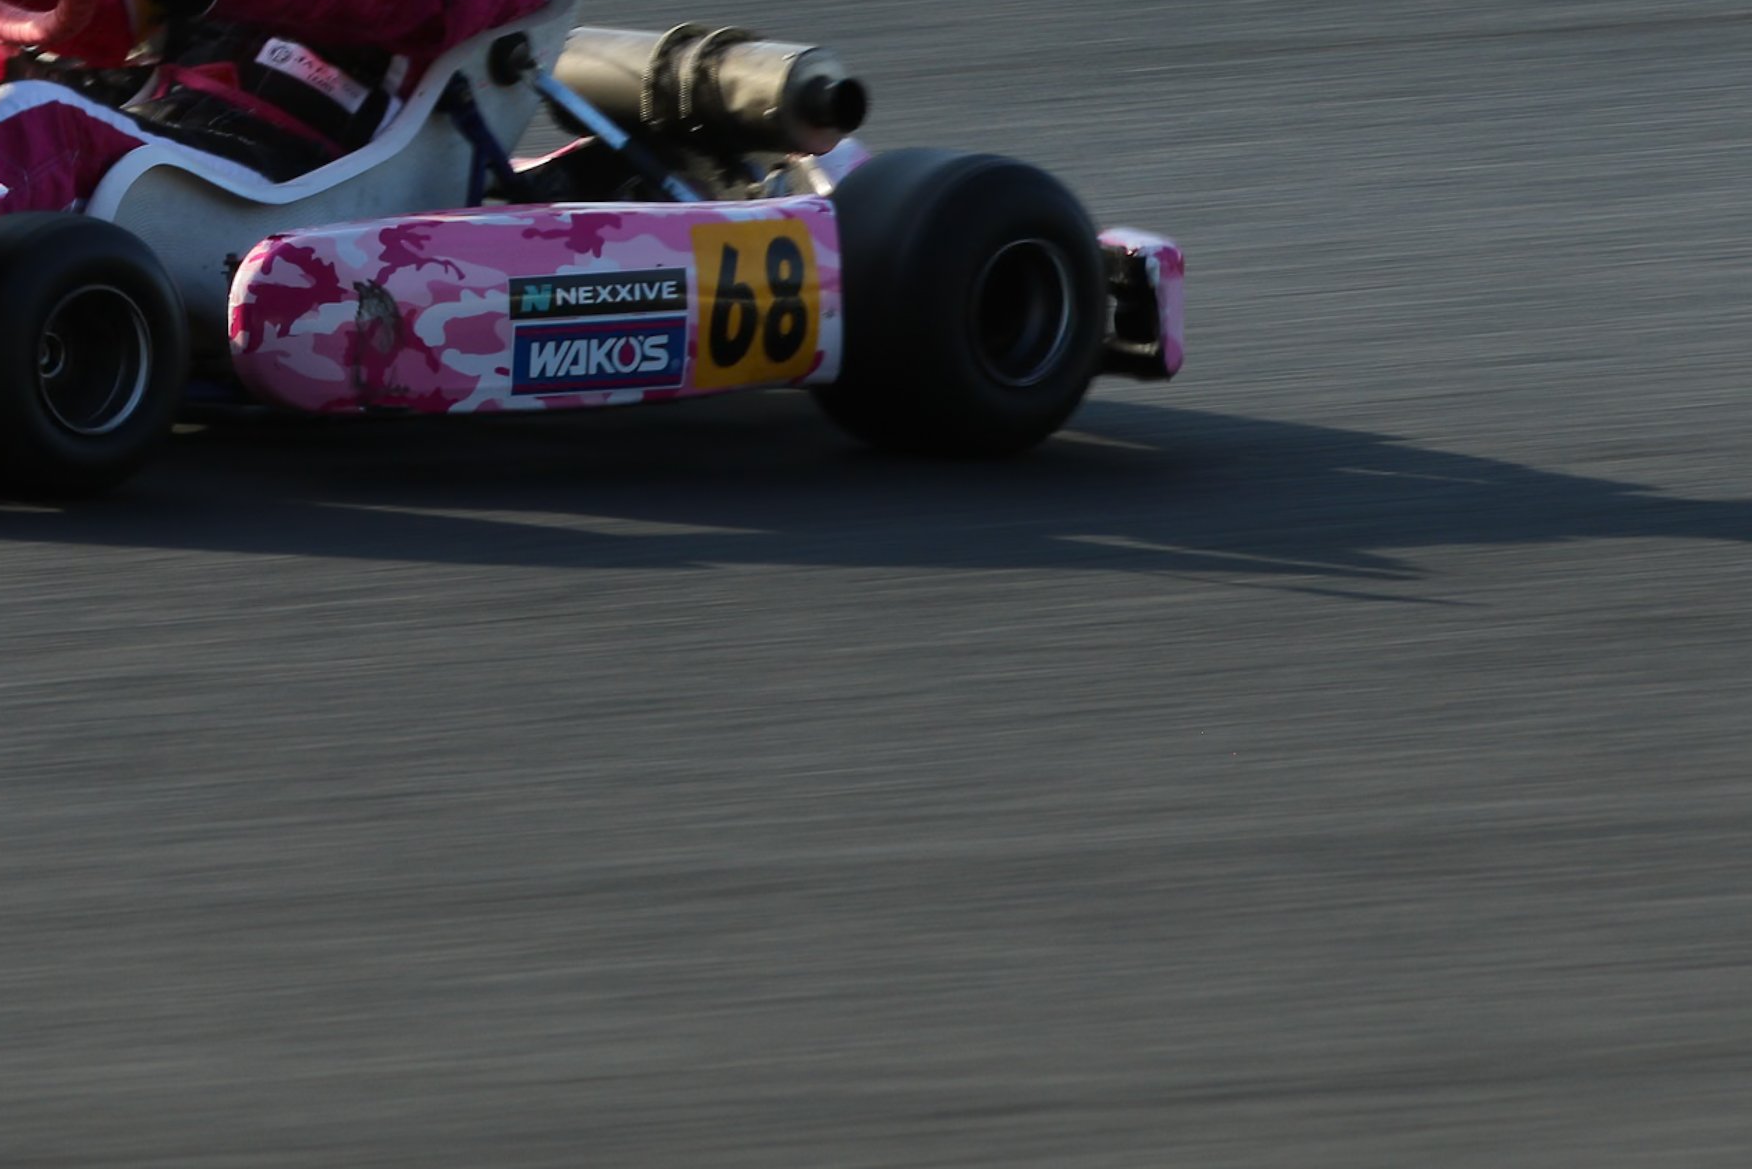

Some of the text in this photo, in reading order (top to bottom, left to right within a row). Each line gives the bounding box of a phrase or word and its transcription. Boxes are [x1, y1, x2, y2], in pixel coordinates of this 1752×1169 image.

[556, 281, 679, 305] NEXXIVE
[710, 236, 808, 368] 68
[528, 334, 669, 378] WAKO'S
